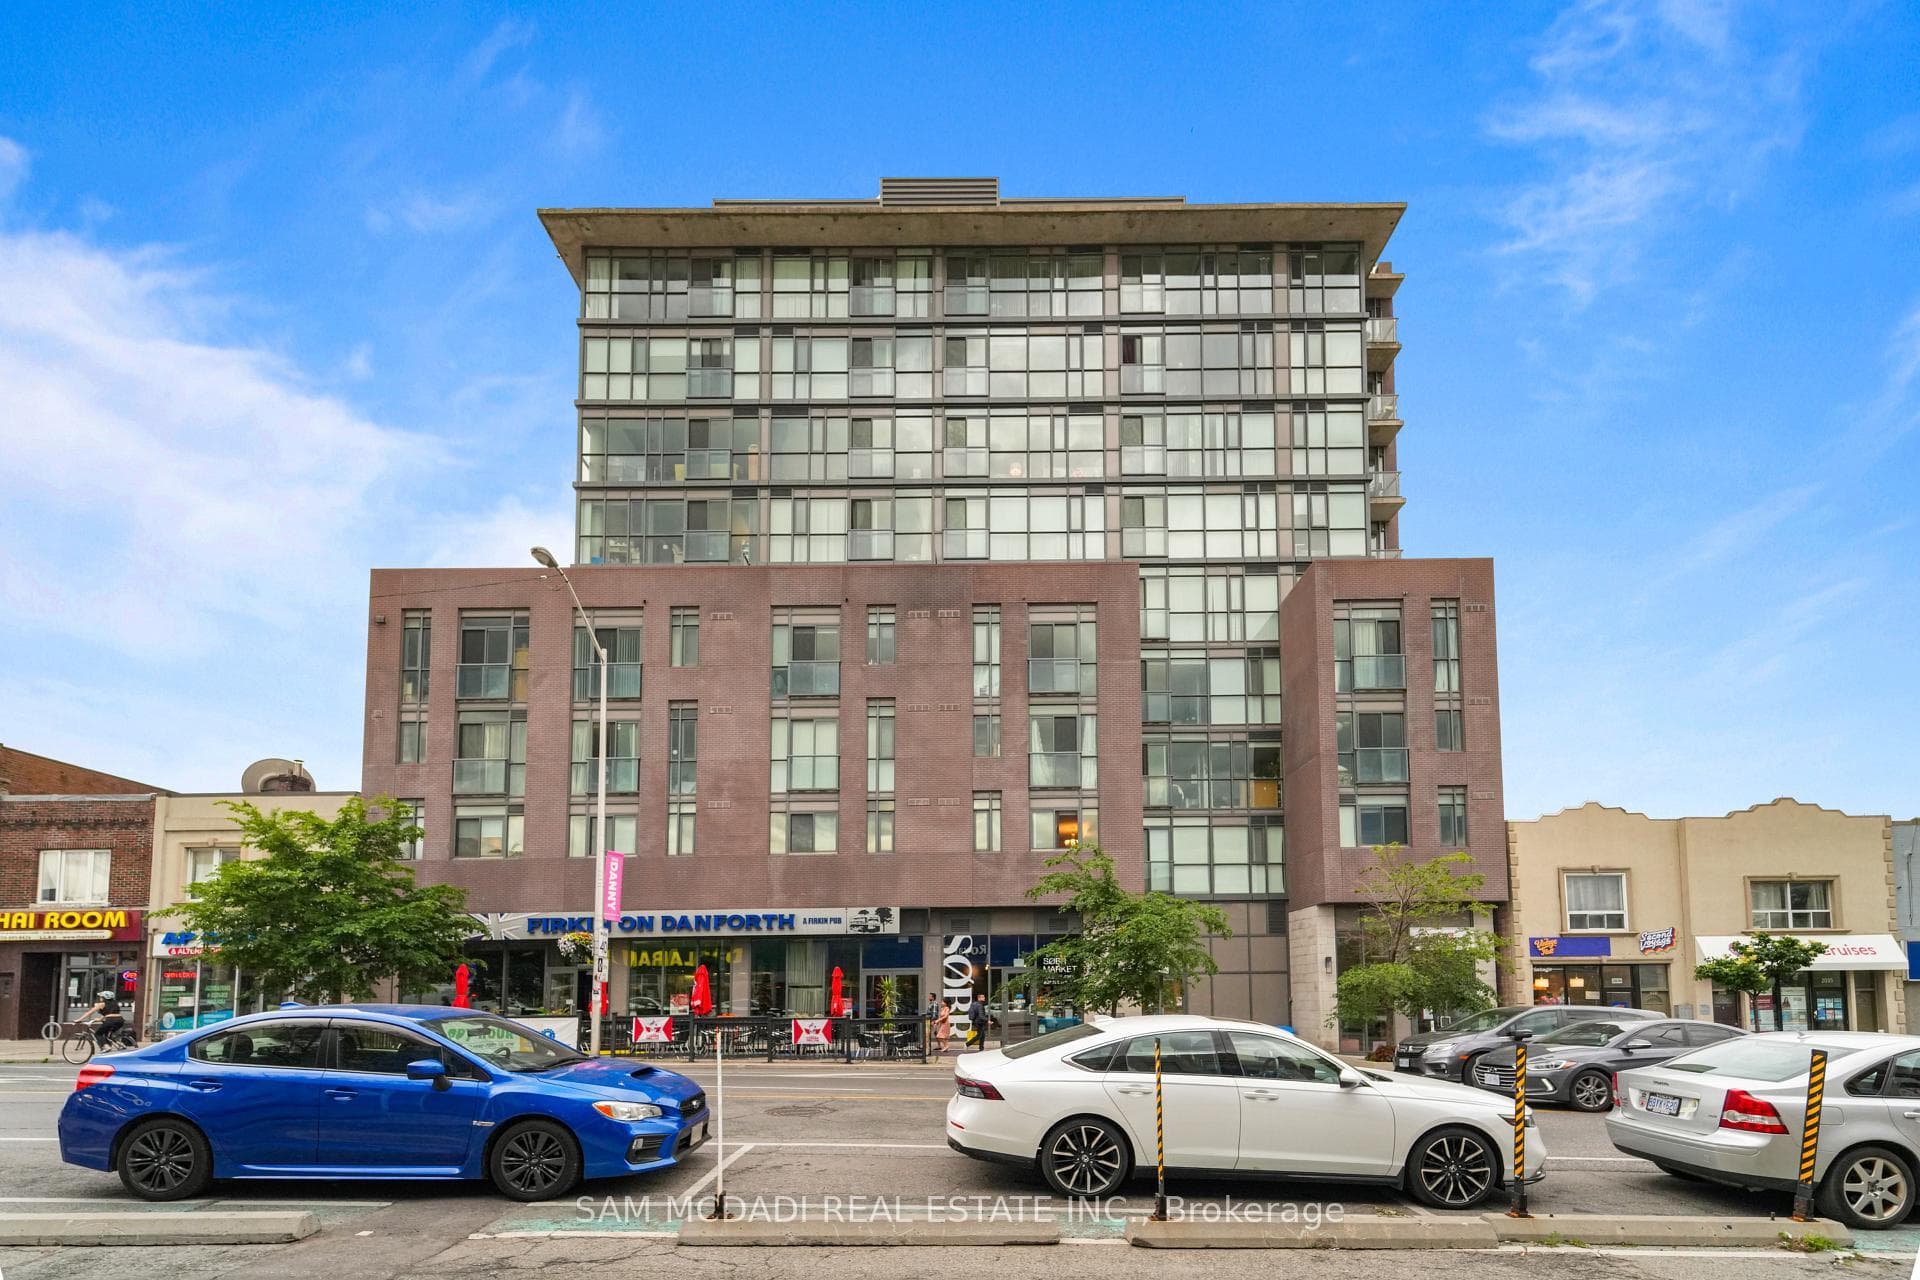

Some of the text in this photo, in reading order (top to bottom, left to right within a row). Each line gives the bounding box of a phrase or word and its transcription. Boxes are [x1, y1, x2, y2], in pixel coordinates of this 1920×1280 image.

[607, 861, 619, 911] DANNY
[43, 910, 127, 929] ROOM
[527, 913, 795, 934] FIRKI ON DANFORTH
[802, 917, 842, 925] A FIRKIN PUB
[1639, 927, 1673, 942] Second
[1042, 965, 1078, 973] MARKET
